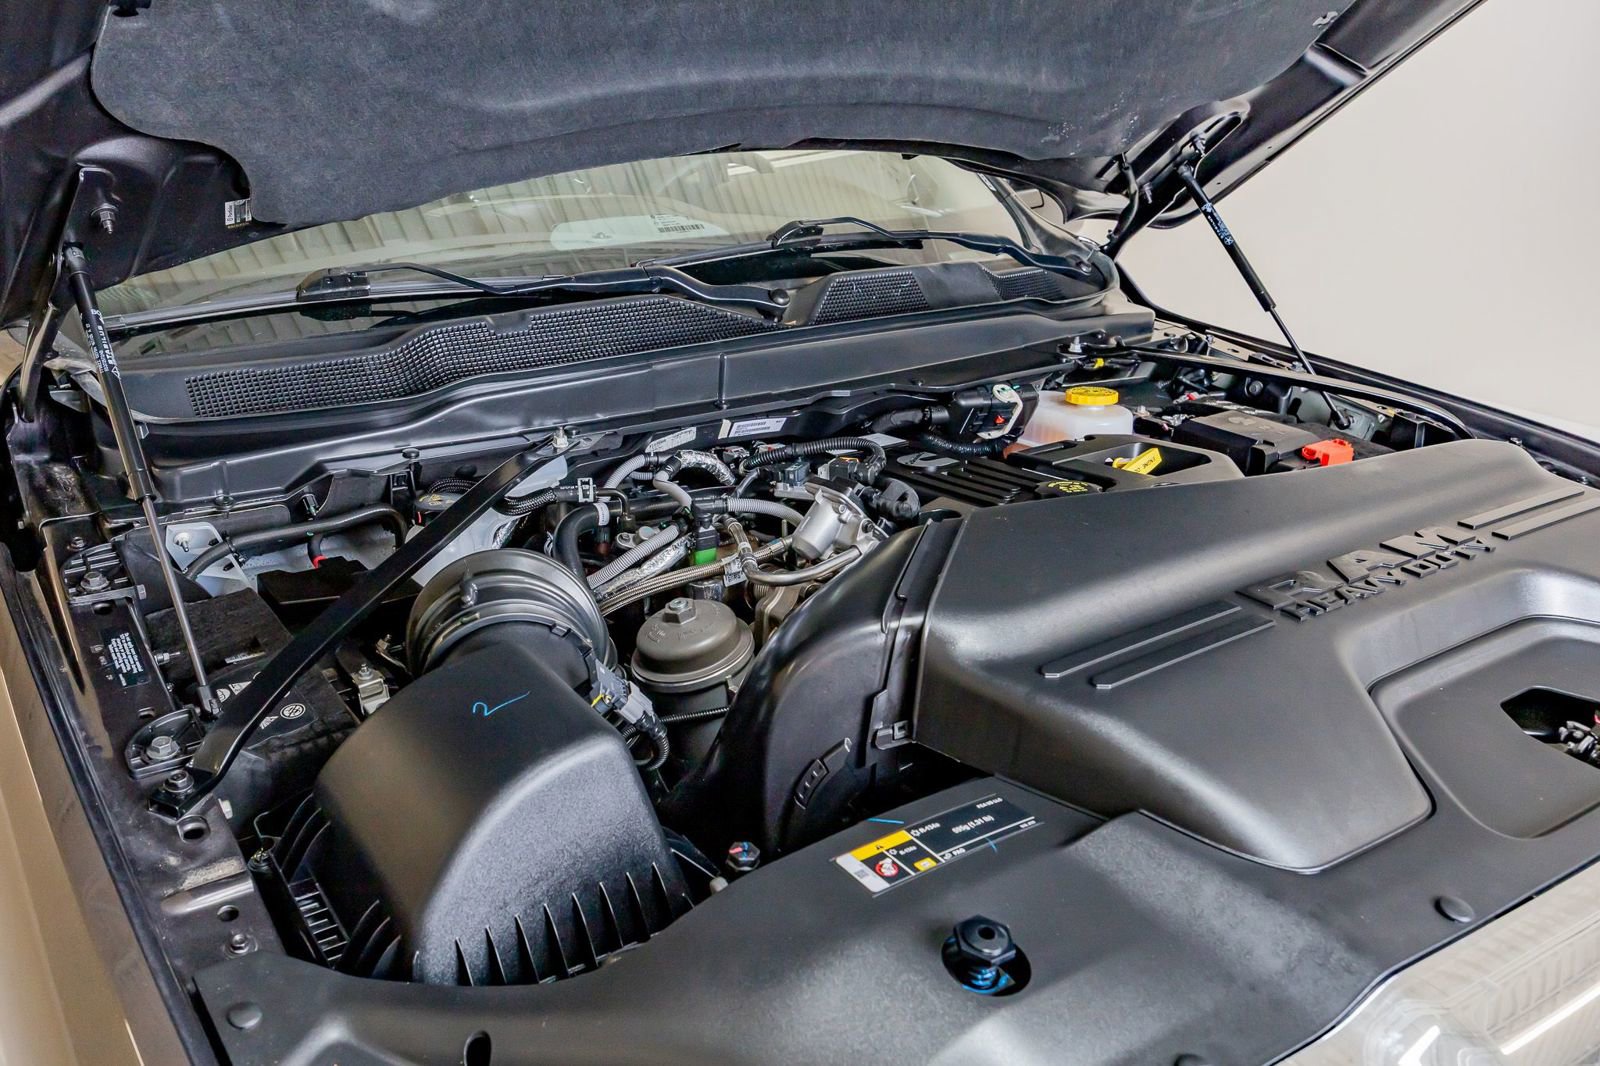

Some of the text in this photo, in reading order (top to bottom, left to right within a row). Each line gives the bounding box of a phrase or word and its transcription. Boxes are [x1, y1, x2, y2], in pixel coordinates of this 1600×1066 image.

[1235, 525, 1477, 610] RAM
[1280, 538, 1497, 622] HEAVY DUTY
